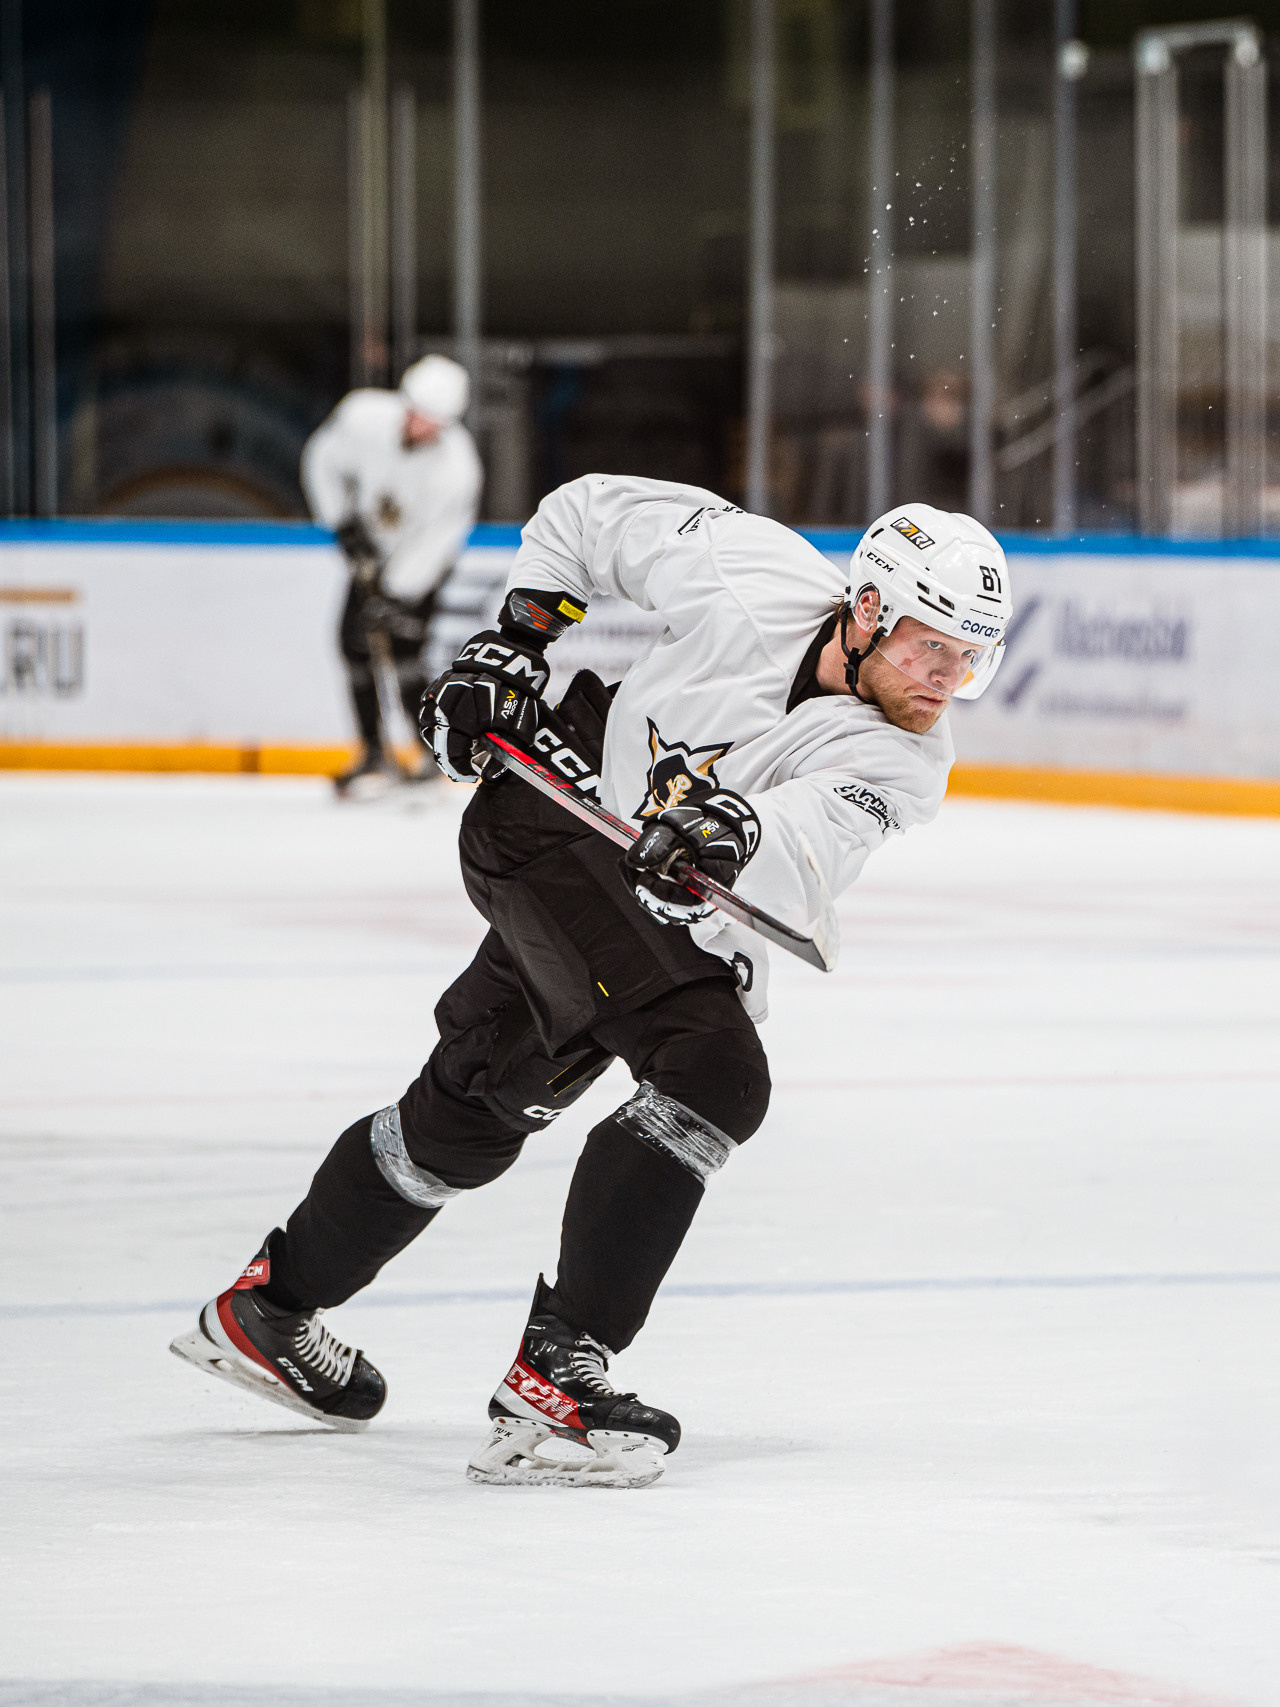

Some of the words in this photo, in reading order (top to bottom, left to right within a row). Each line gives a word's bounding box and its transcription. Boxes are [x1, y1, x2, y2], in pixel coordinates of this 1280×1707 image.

[891, 517, 934, 549] PARI
[866, 551, 895, 573] CCM
[979, 565, 1002, 594] 81
[455, 642, 548, 691] CCM
[276, 1356, 314, 1392] CCM
[506, 1362, 575, 1421] CCM
